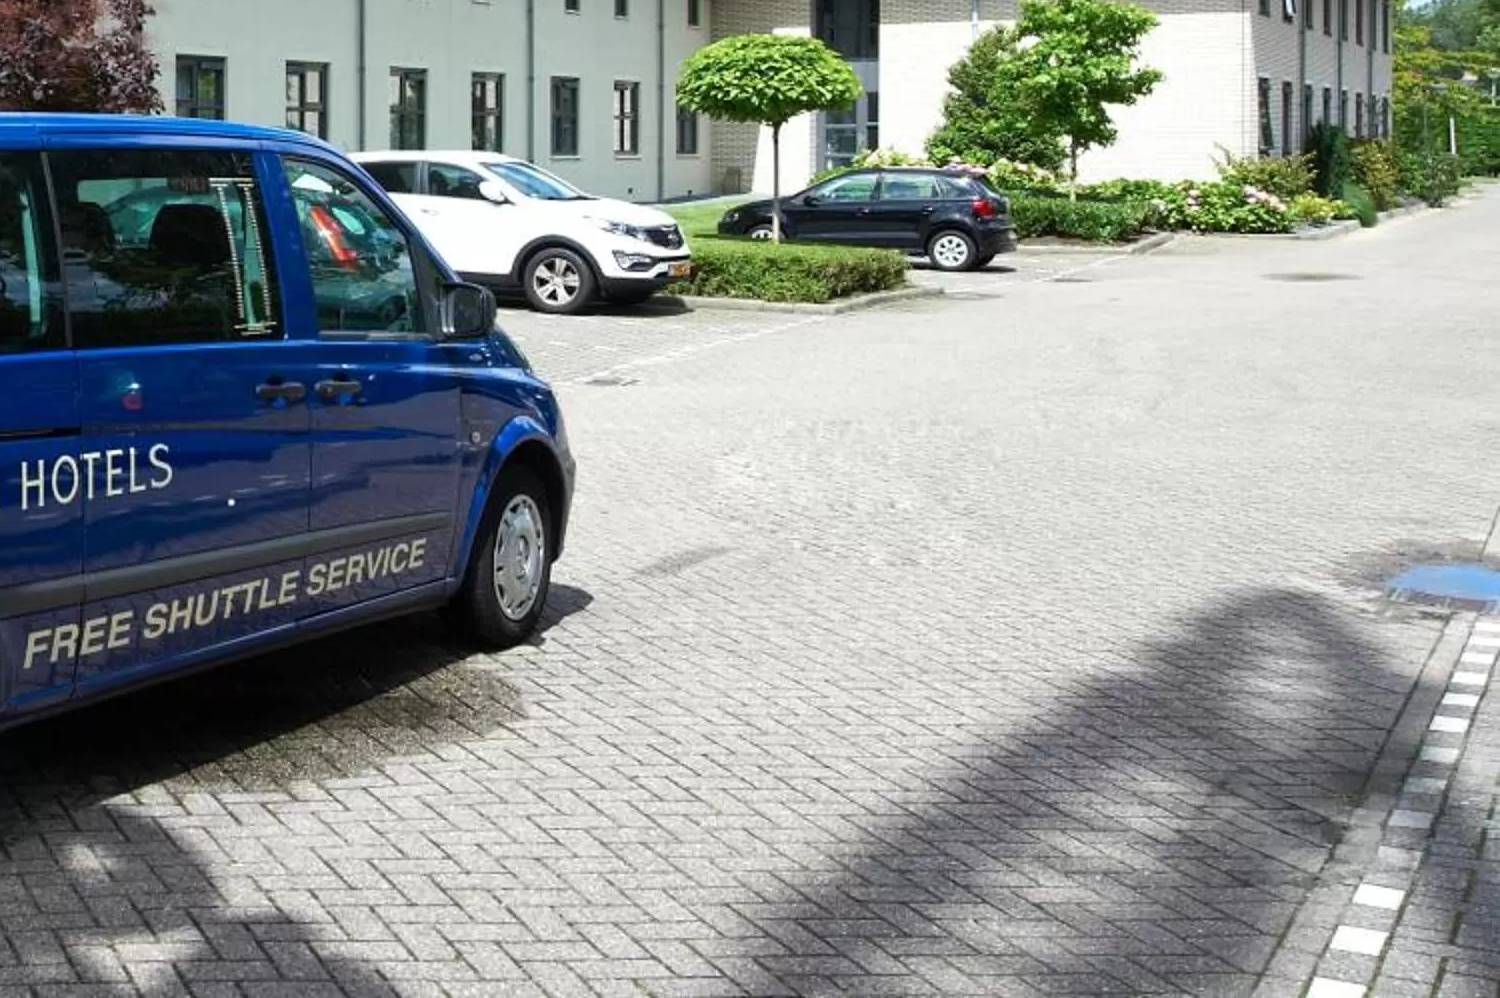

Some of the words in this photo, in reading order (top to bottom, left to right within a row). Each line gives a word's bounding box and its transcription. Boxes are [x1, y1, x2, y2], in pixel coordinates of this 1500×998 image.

[20, 443, 173, 511] HOTELS
[23, 612, 133, 669] FREE
[144, 571, 300, 639] SHUTTLE
[306, 538, 427, 595] SERVICE
